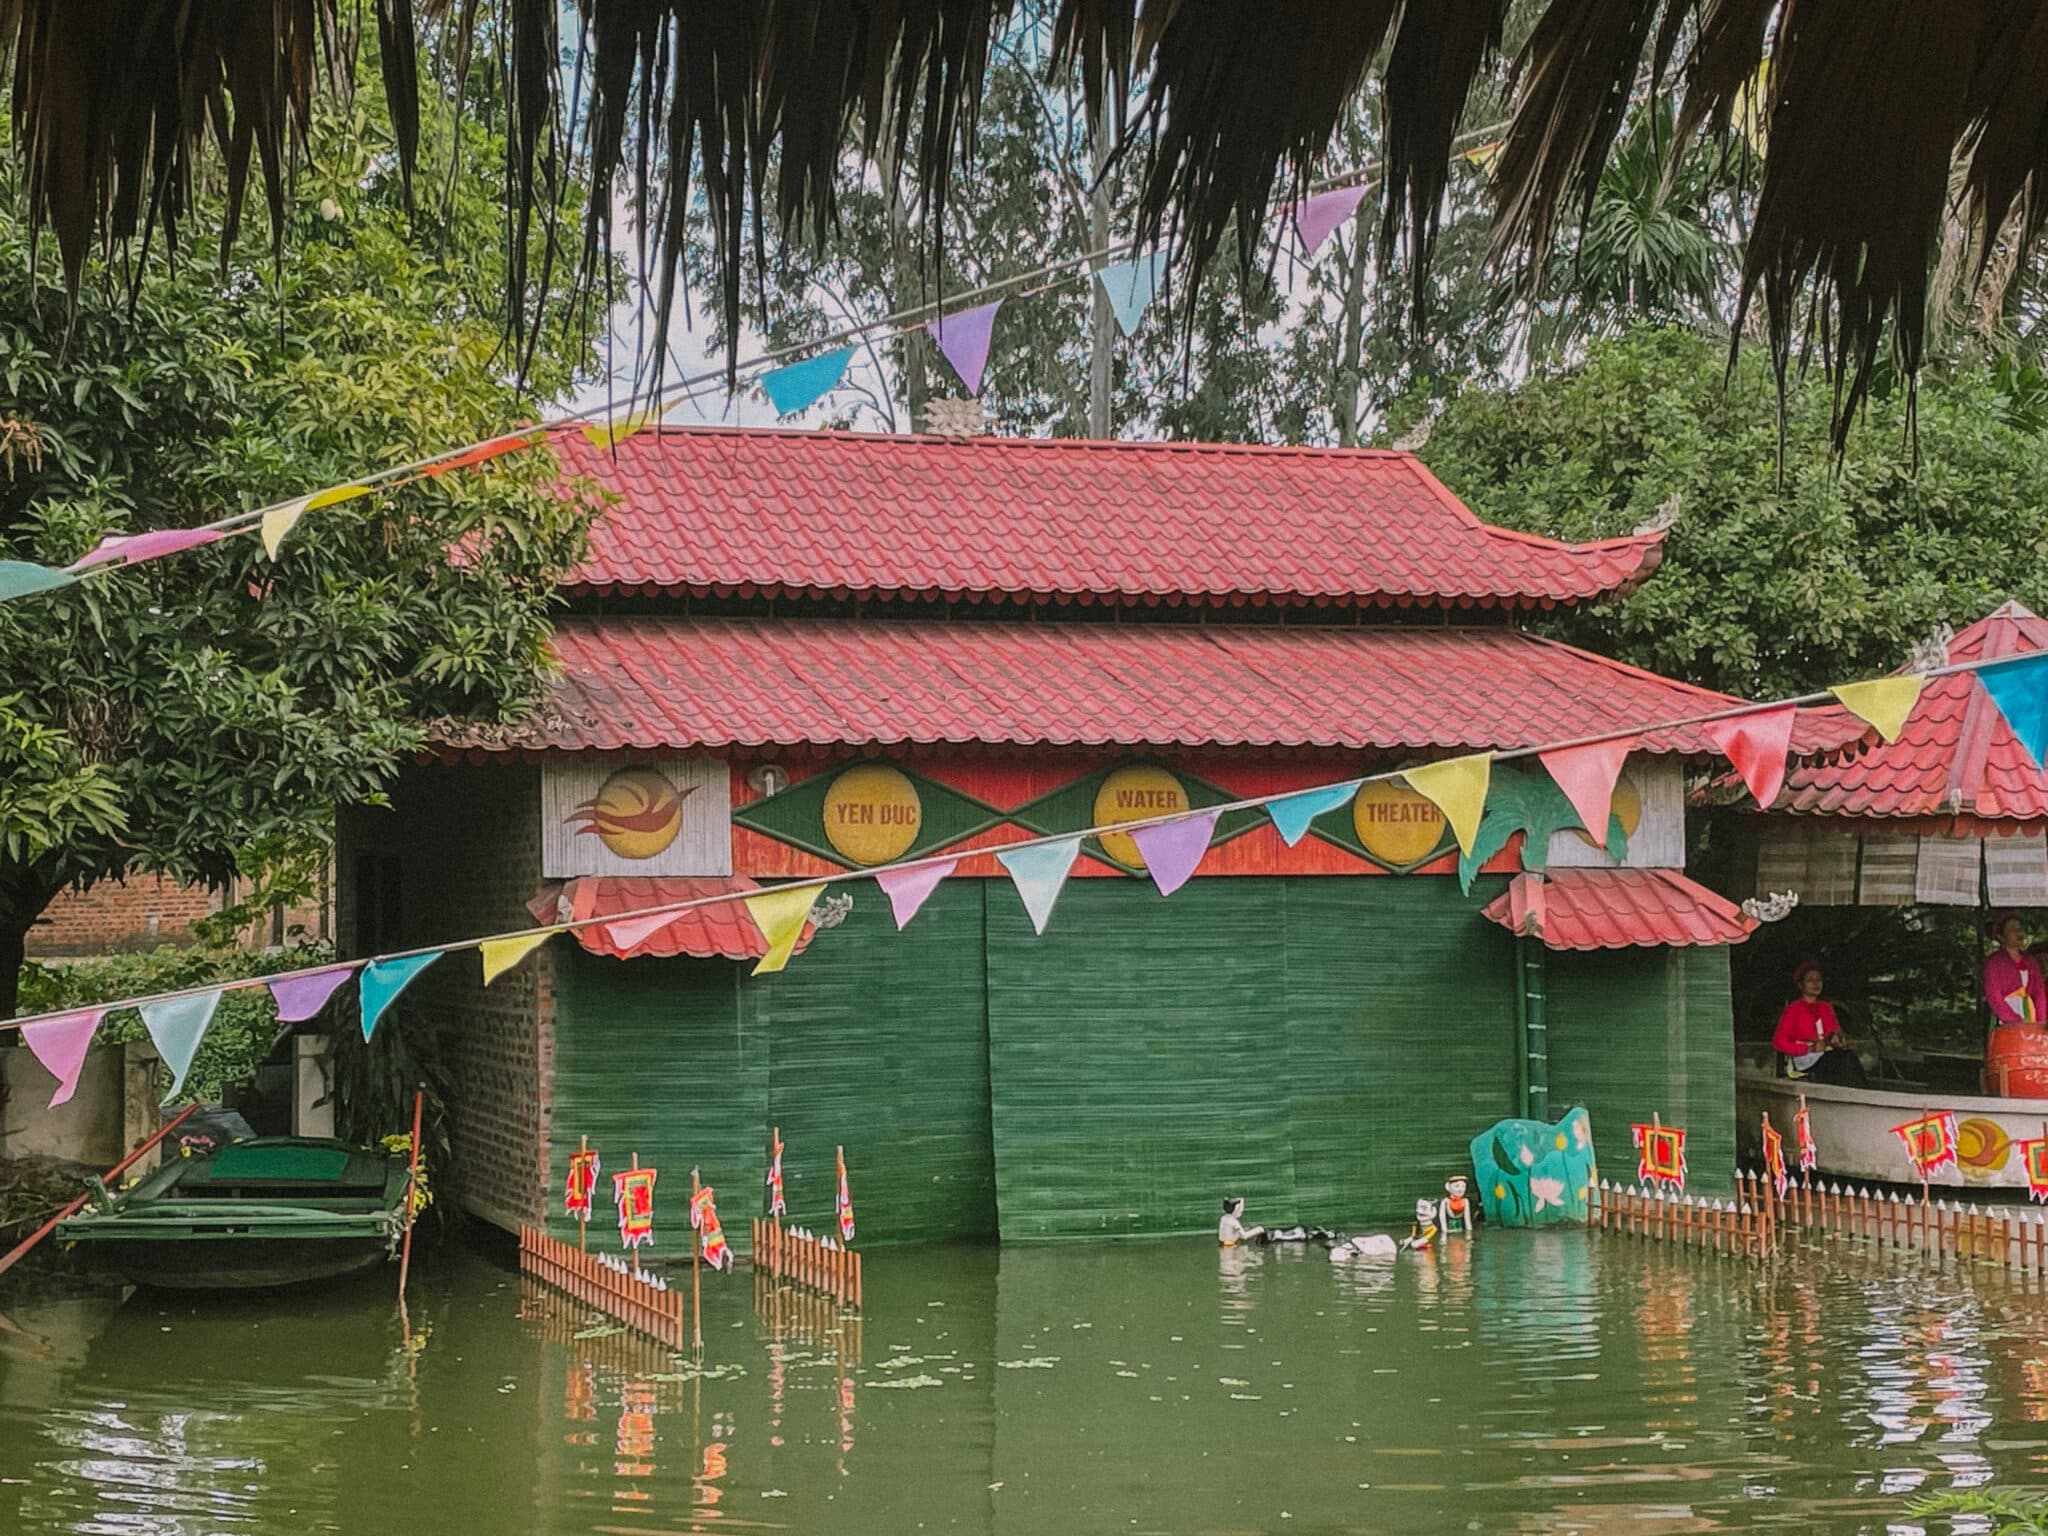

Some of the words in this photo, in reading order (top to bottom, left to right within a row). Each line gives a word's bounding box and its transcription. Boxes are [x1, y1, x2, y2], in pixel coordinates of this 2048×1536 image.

[1116, 789, 1178, 808] WATER
[837, 803, 873, 825] YEN
[880, 803, 916, 826] DUC
[1366, 802, 1440, 823] THEATER
